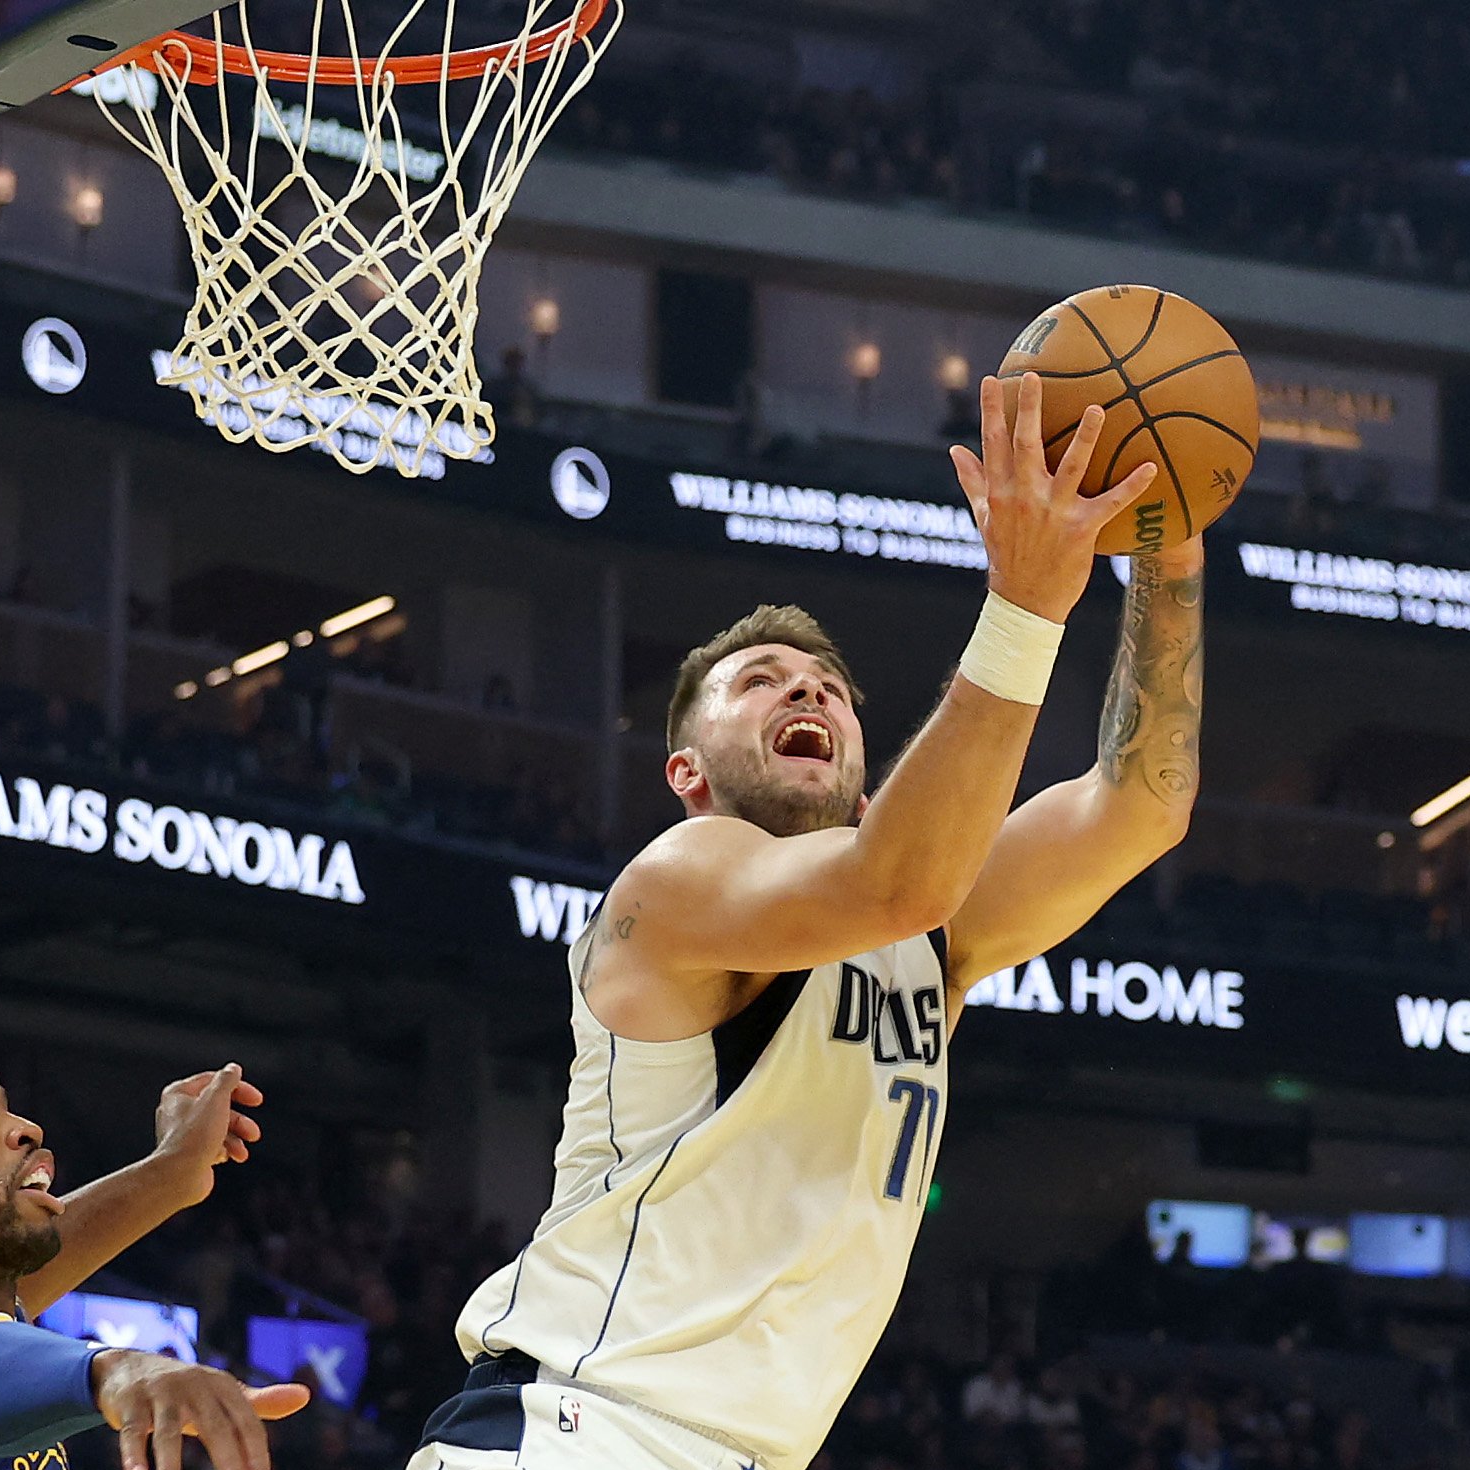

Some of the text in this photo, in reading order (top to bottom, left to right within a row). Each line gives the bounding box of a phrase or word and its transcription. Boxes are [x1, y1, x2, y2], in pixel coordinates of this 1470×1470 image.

[841, 527, 879, 557] TO
[1399, 597, 1435, 625] TO
[113, 798, 366, 904] SONOMA
[1070, 957, 1244, 1029] HOME
